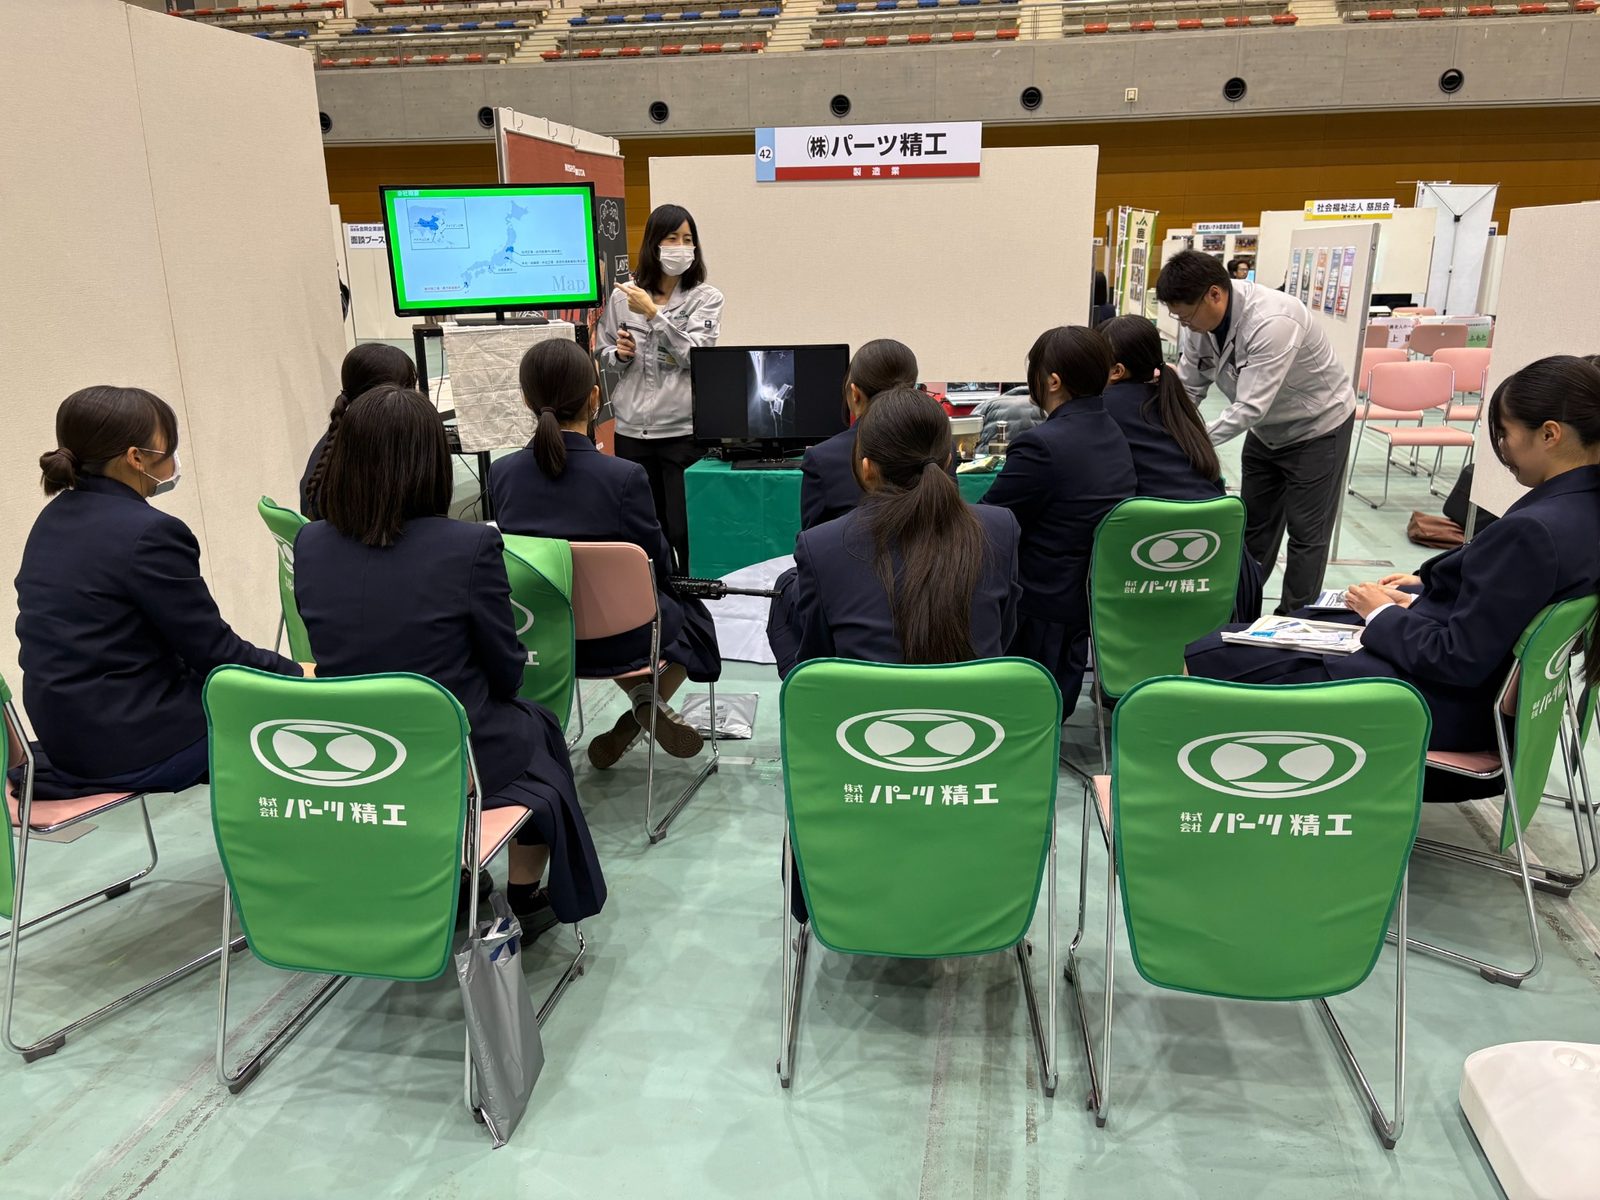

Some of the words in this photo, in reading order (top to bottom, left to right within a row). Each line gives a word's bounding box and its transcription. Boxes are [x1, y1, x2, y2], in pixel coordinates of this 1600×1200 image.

[760, 148, 771, 159] 42
[807, 133, 948, 159] (株)パーツ精工
[853, 166, 899, 177] 製造業
[552, 276, 586, 293] Map
[1139, 578, 1210, 594] パーツ精工
[870, 783, 1000, 806] パーツ精工
[284, 798, 408, 826] パーツ精工
[1208, 812, 1353, 837] パーツ精工
